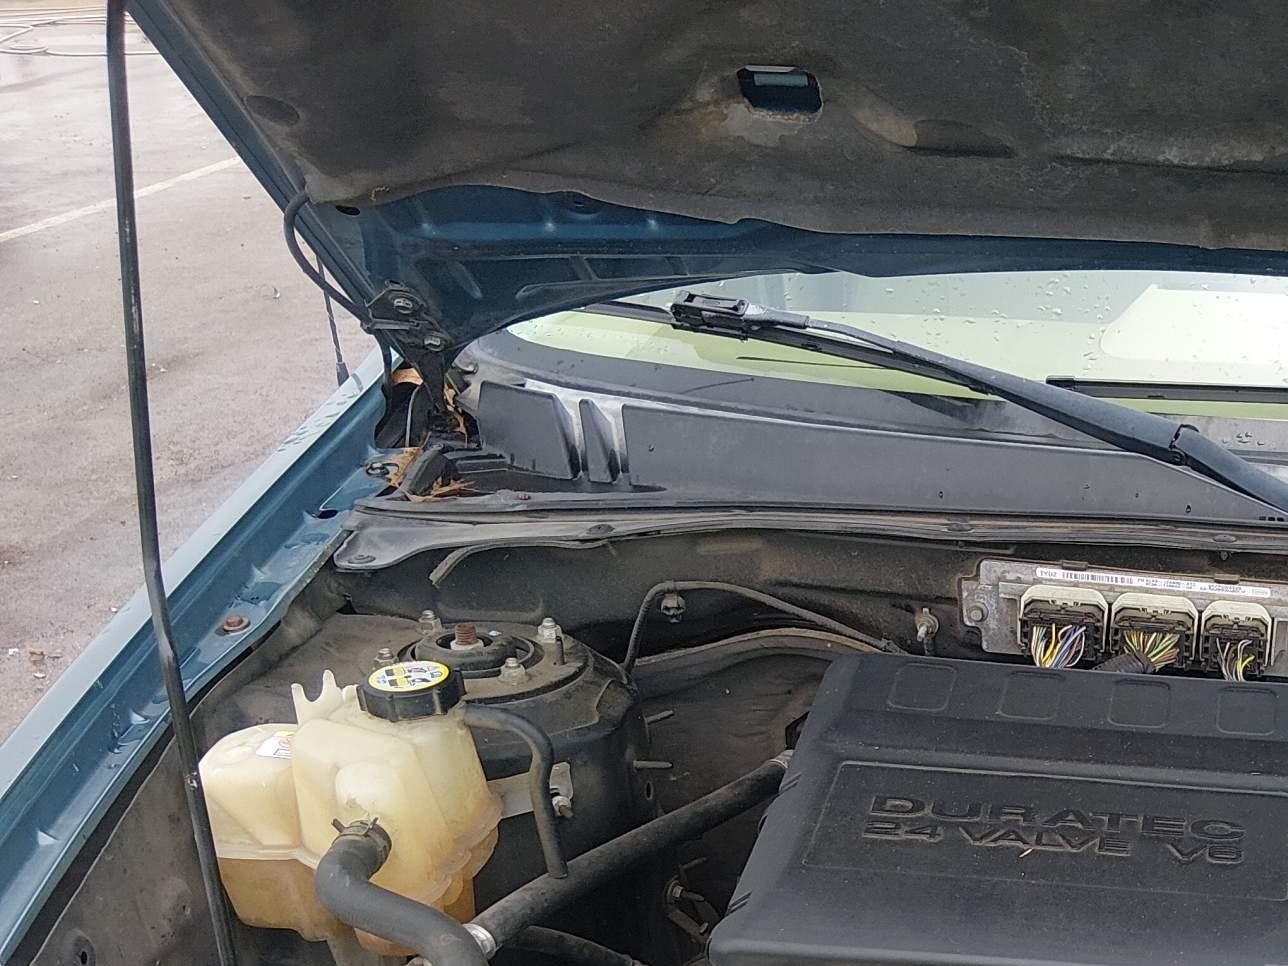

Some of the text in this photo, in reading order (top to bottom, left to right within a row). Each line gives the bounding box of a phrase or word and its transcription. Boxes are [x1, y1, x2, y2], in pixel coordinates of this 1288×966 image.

[870, 795, 1246, 841] DURATEC
[863, 819, 1246, 864] 24 VALVE V6
